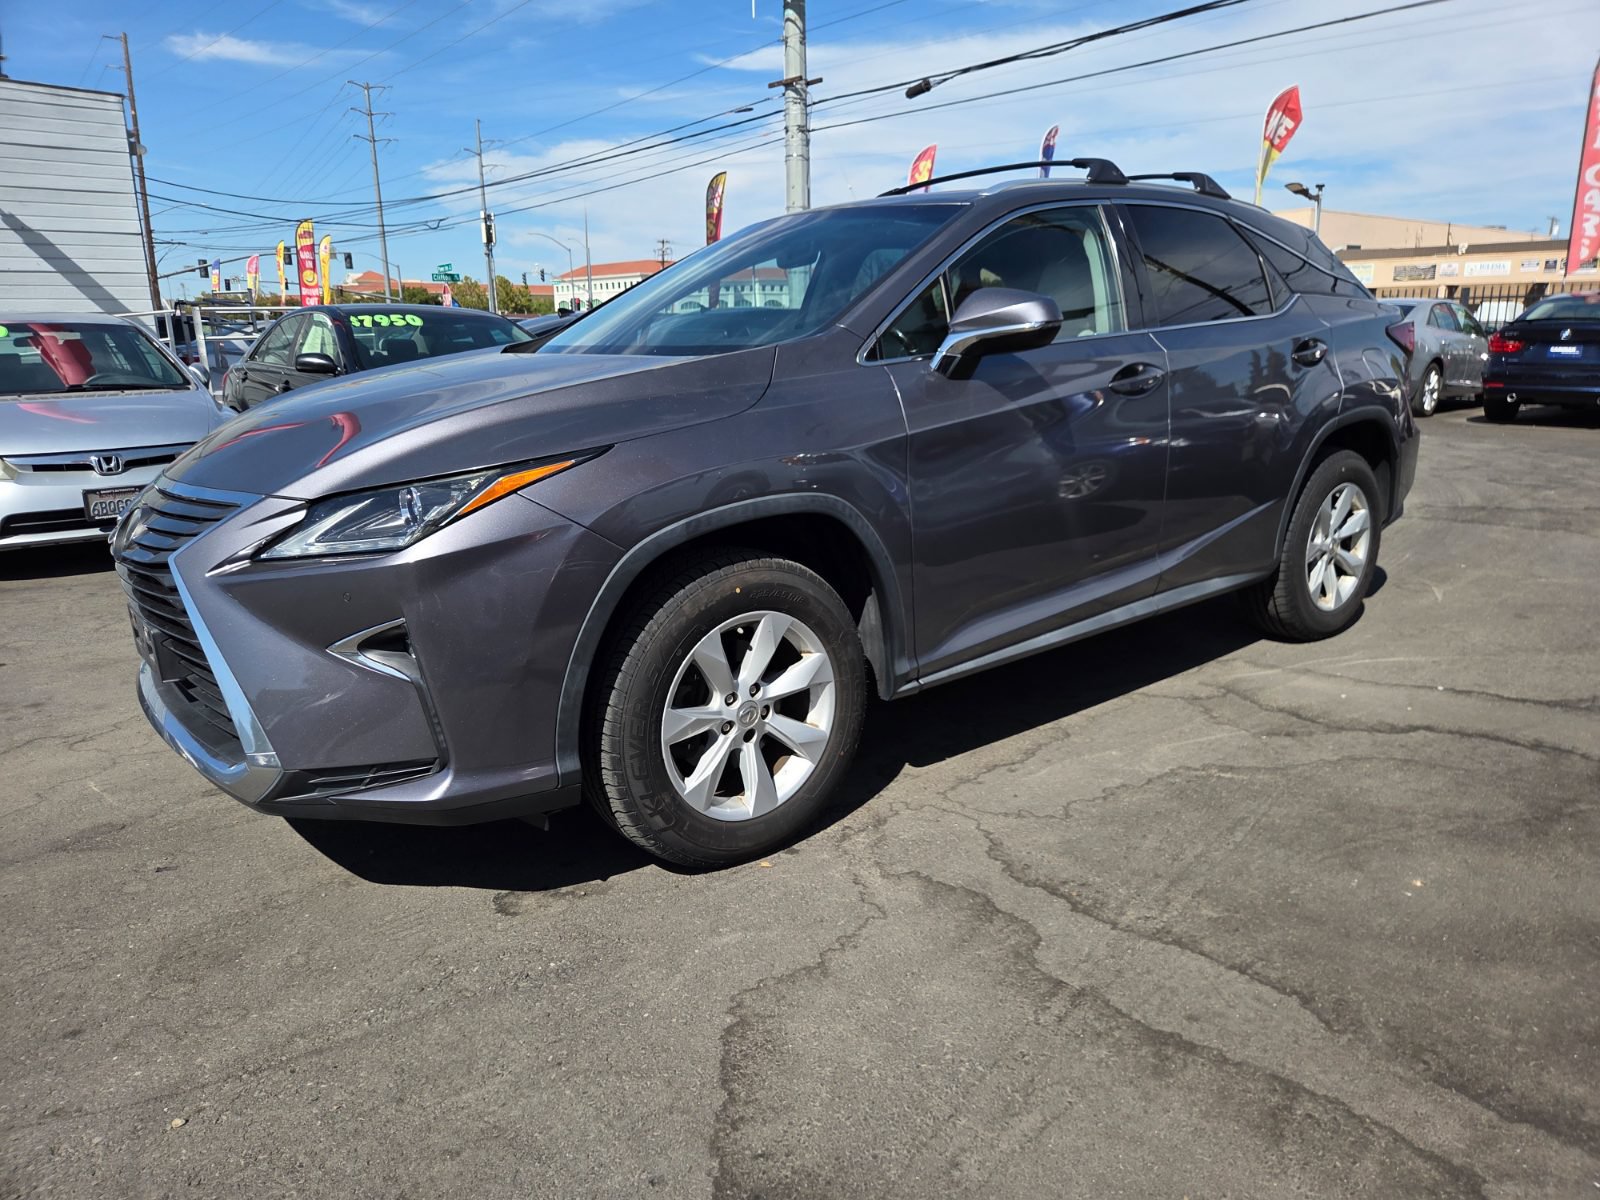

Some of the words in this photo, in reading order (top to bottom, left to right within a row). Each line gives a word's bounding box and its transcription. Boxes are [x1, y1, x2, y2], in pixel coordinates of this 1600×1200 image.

[1264, 109, 1296, 146] WE
[305, 297, 319, 306] OUT
[350, 314, 424, 328] $7950
